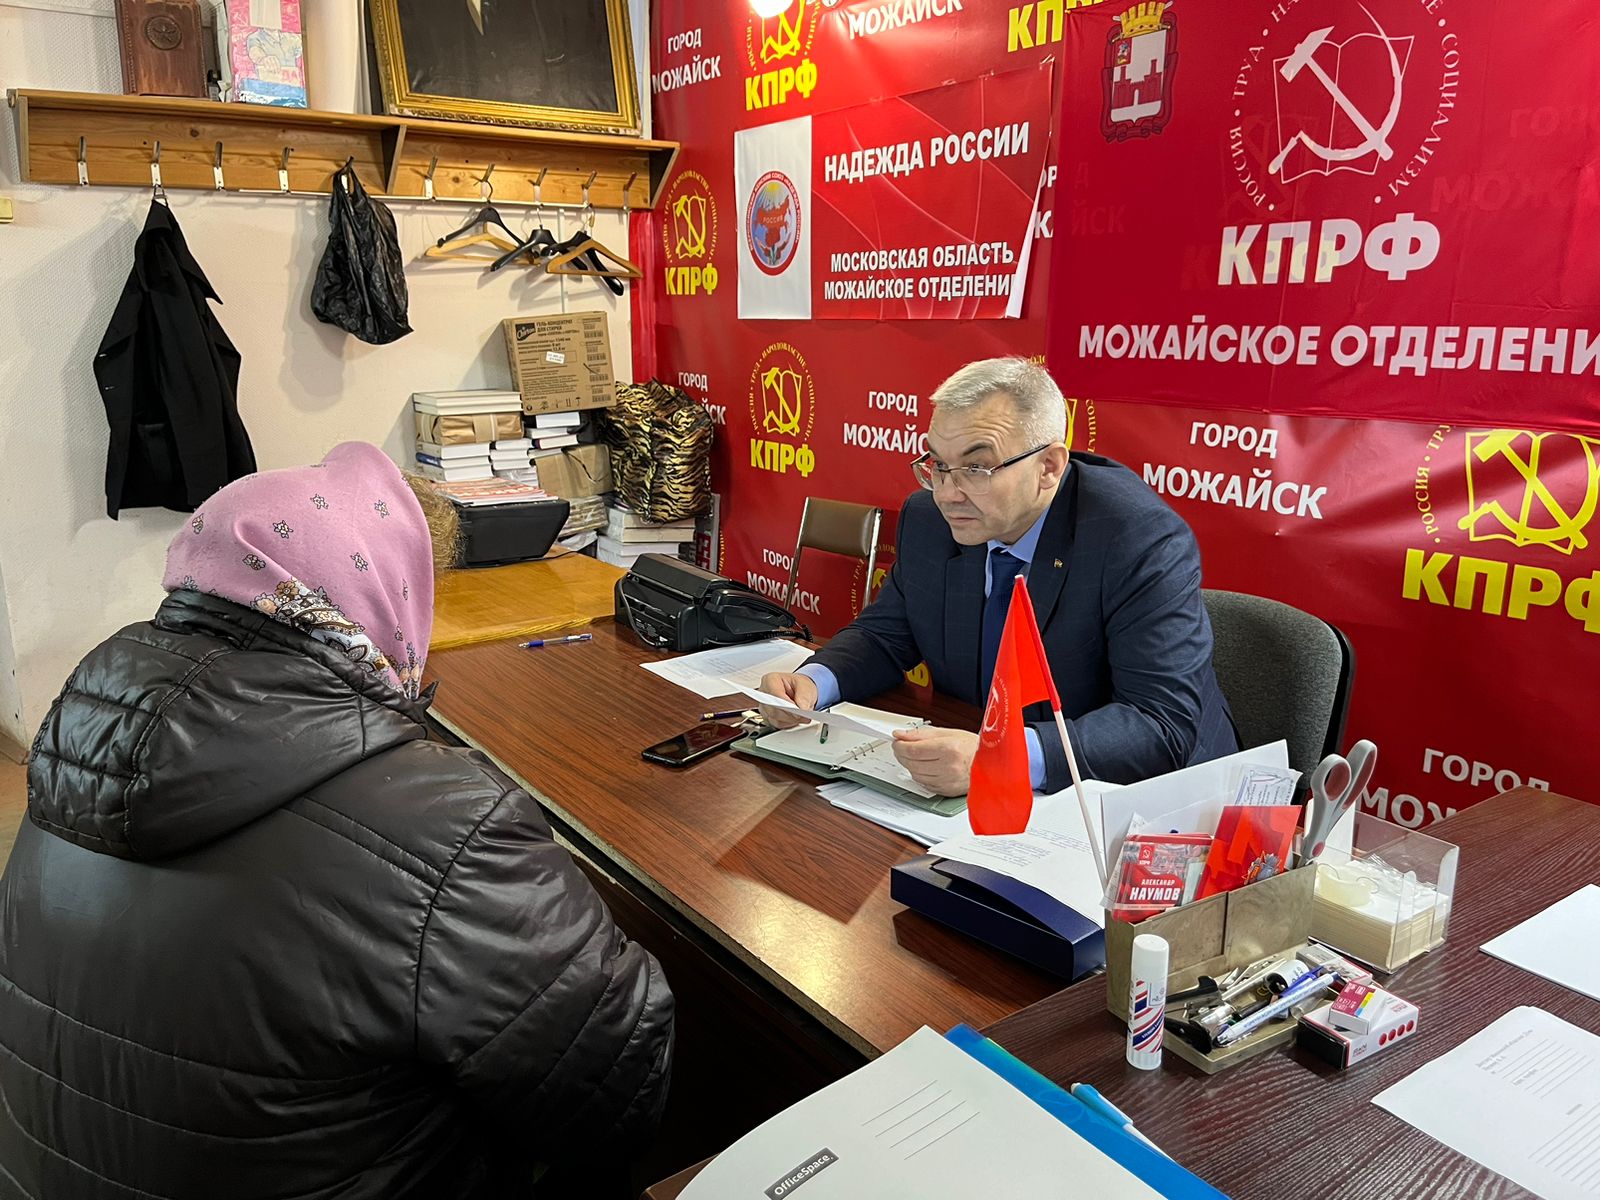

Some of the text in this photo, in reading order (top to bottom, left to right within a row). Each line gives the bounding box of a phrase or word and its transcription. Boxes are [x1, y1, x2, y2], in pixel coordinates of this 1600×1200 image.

[668, 28, 702, 54] ГОРОД
[745, 58, 818, 111] КПРФ
[1233, 45, 1265, 99] ТРУД
[1389, 32, 1460, 197] СОЦИАЛИЗМ
[824, 121, 1030, 184] НАДЕЖДА РОССИИ
[1229, 126, 1266, 207] РОССИЯ
[831, 241, 1014, 272] МОСКОВСКАЯ ОБЛАСТЬ
[1217, 212, 1441, 286] КПРФ
[664, 263, 719, 295] КПРФ
[824, 276, 914, 300] МОЖАЙСКОЕ
[1079, 315, 1321, 366] МОЖАЙСКОЕ
[678, 372, 708, 392] ГОРОД
[868, 391, 918, 417] ГОРОД
[750, 438, 815, 478] КПРФ
[843, 422, 929, 456] МОЖАЙС
[1190, 421, 1279, 459] ГОРОД
[1143, 462, 1328, 520] МОЖАЙСК
[1415, 466, 1439, 535] РОССИЯ
[1129, 887, 1181, 901] НАУМОВ
[774, 1154, 830, 1195] OfficeSpace
